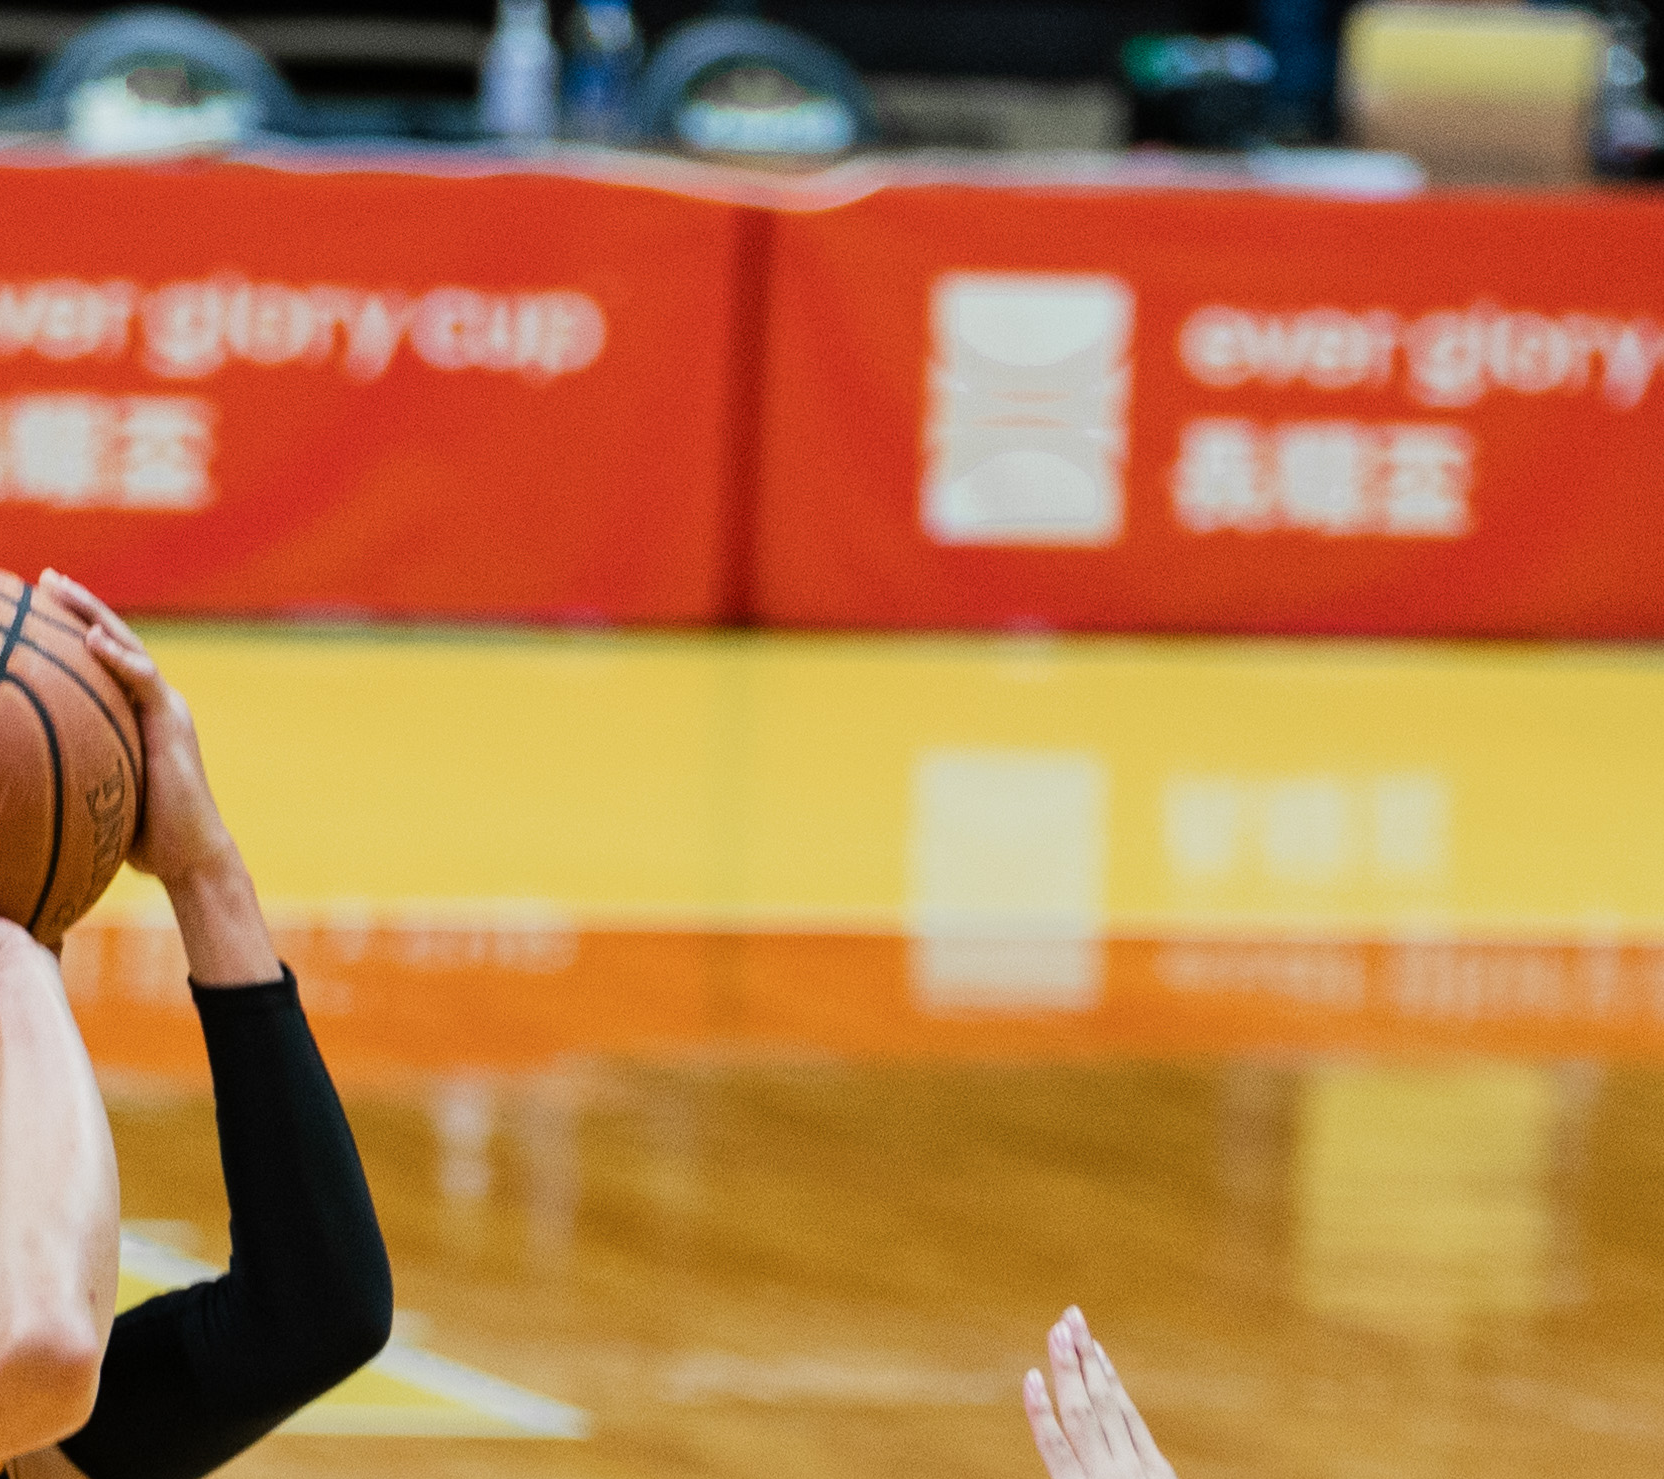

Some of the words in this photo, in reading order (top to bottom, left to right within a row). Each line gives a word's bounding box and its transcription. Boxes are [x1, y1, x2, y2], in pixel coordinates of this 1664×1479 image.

[140, 266, 412, 380] glory
[410, 278, 610, 380] cup
[1176, 300, 1394, 388] ever
[1406, 294, 1662, 408] glory
